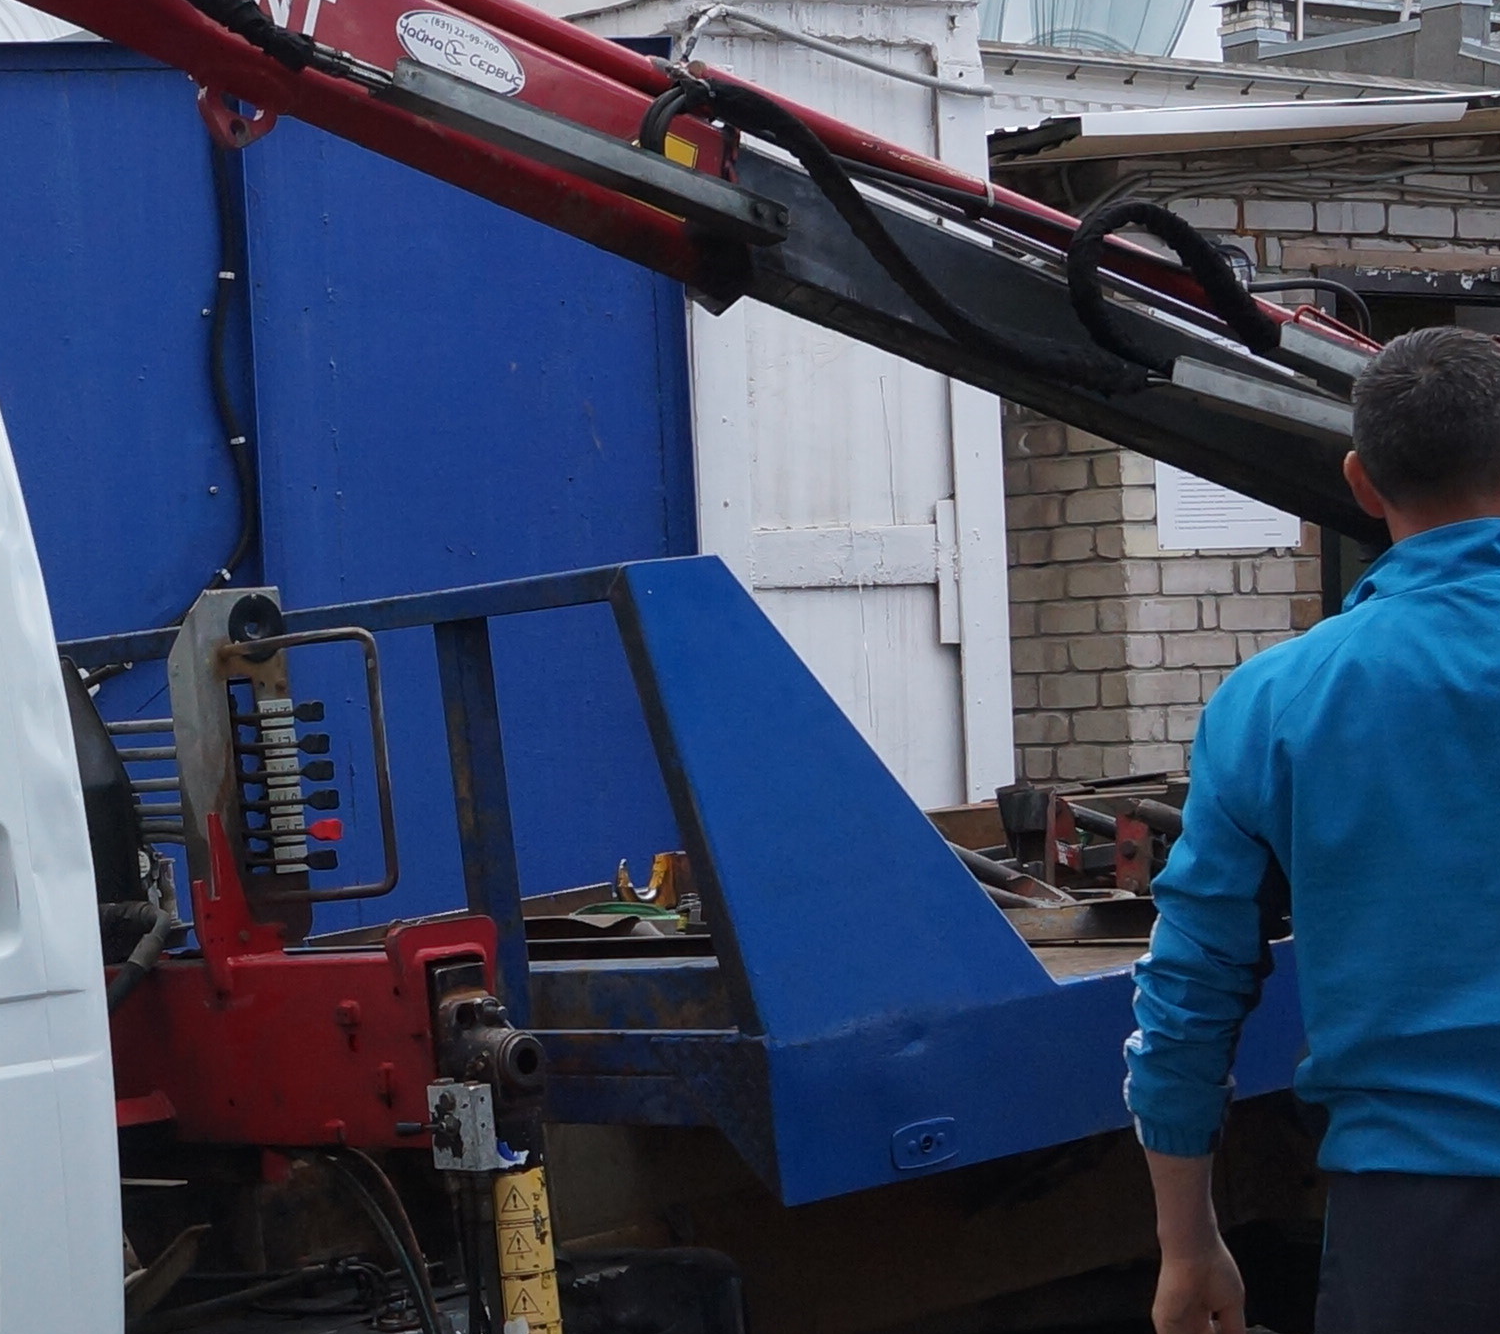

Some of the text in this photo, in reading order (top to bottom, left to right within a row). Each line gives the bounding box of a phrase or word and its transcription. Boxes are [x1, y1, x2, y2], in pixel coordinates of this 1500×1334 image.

[399, 19, 444, 51] Чайка
[430, 17, 500, 54] (831) 22-99-700
